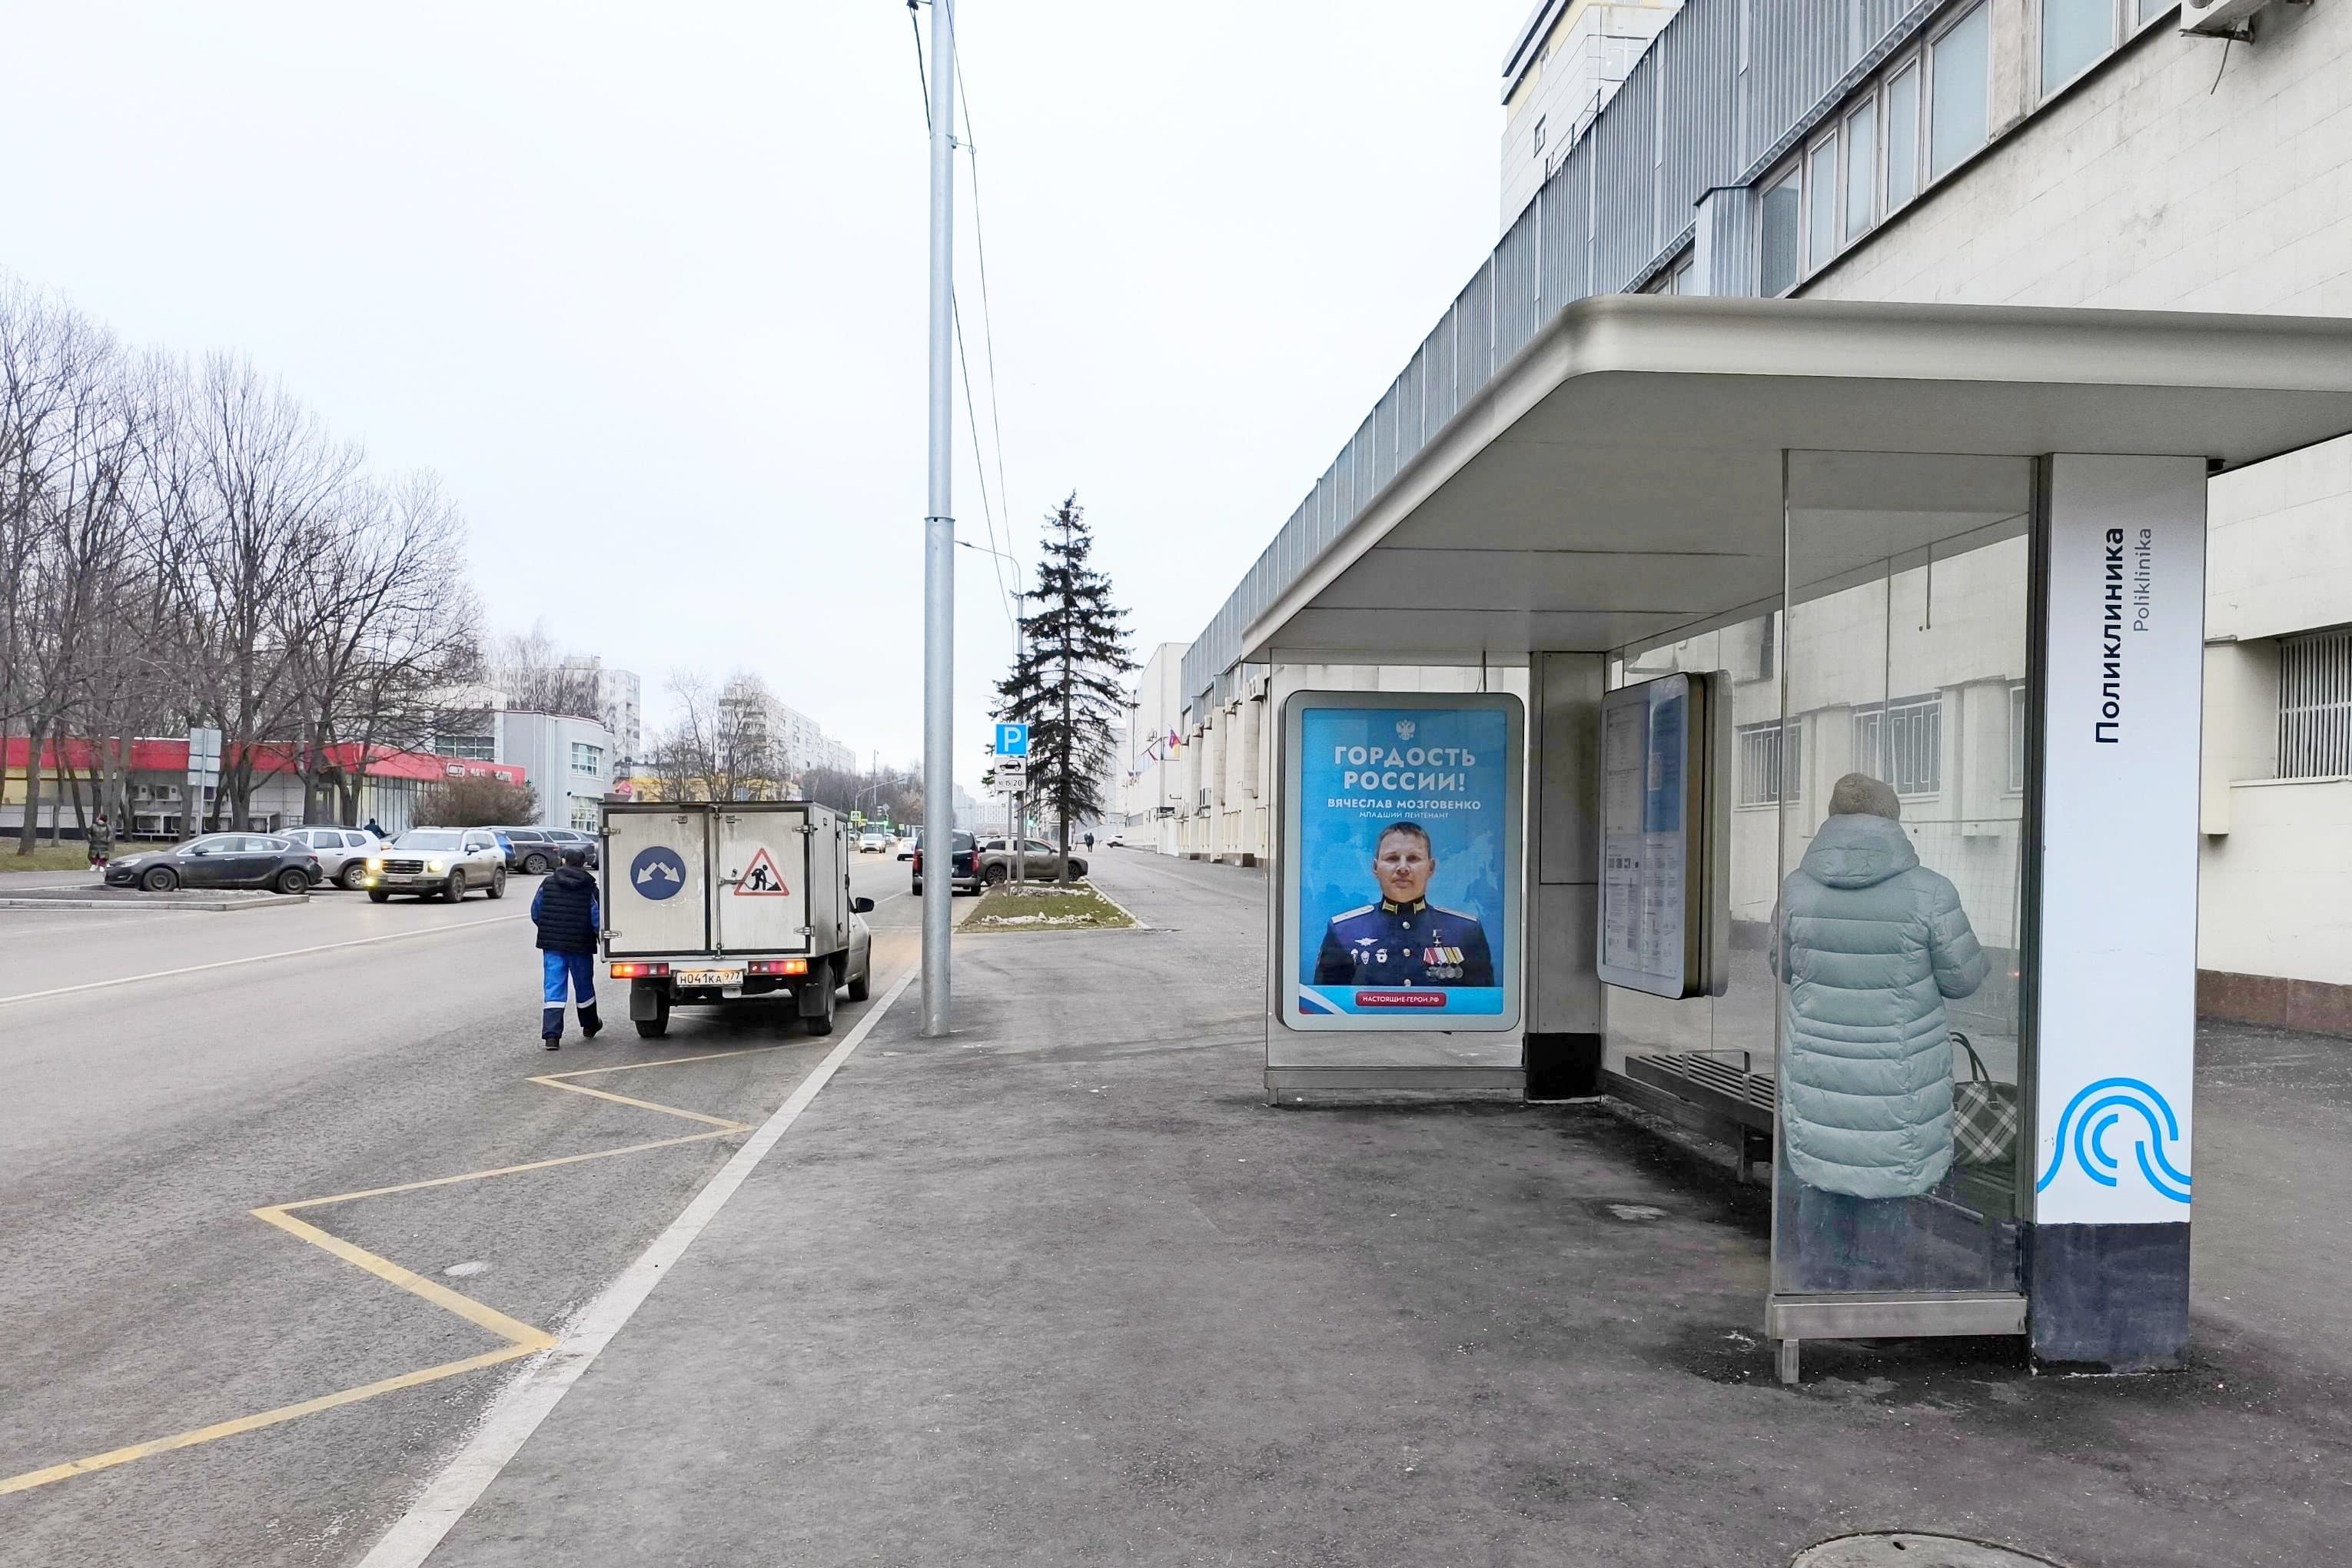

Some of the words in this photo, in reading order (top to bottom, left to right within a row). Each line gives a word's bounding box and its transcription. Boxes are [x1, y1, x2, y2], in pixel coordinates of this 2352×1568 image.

[2133, 528, 2151, 631] Poliklinika
[2095, 528, 2124, 743] Поликлиника
[1334, 746, 1476, 768] ГОРДОСТЬ
[1344, 771, 1465, 791] РОССИИ!
[1327, 798, 1393, 809] ВЯЧЕСЛАВ
[1397, 799, 1481, 811] МОЗГОВЕНКО
[724, 972, 740, 980] 977
